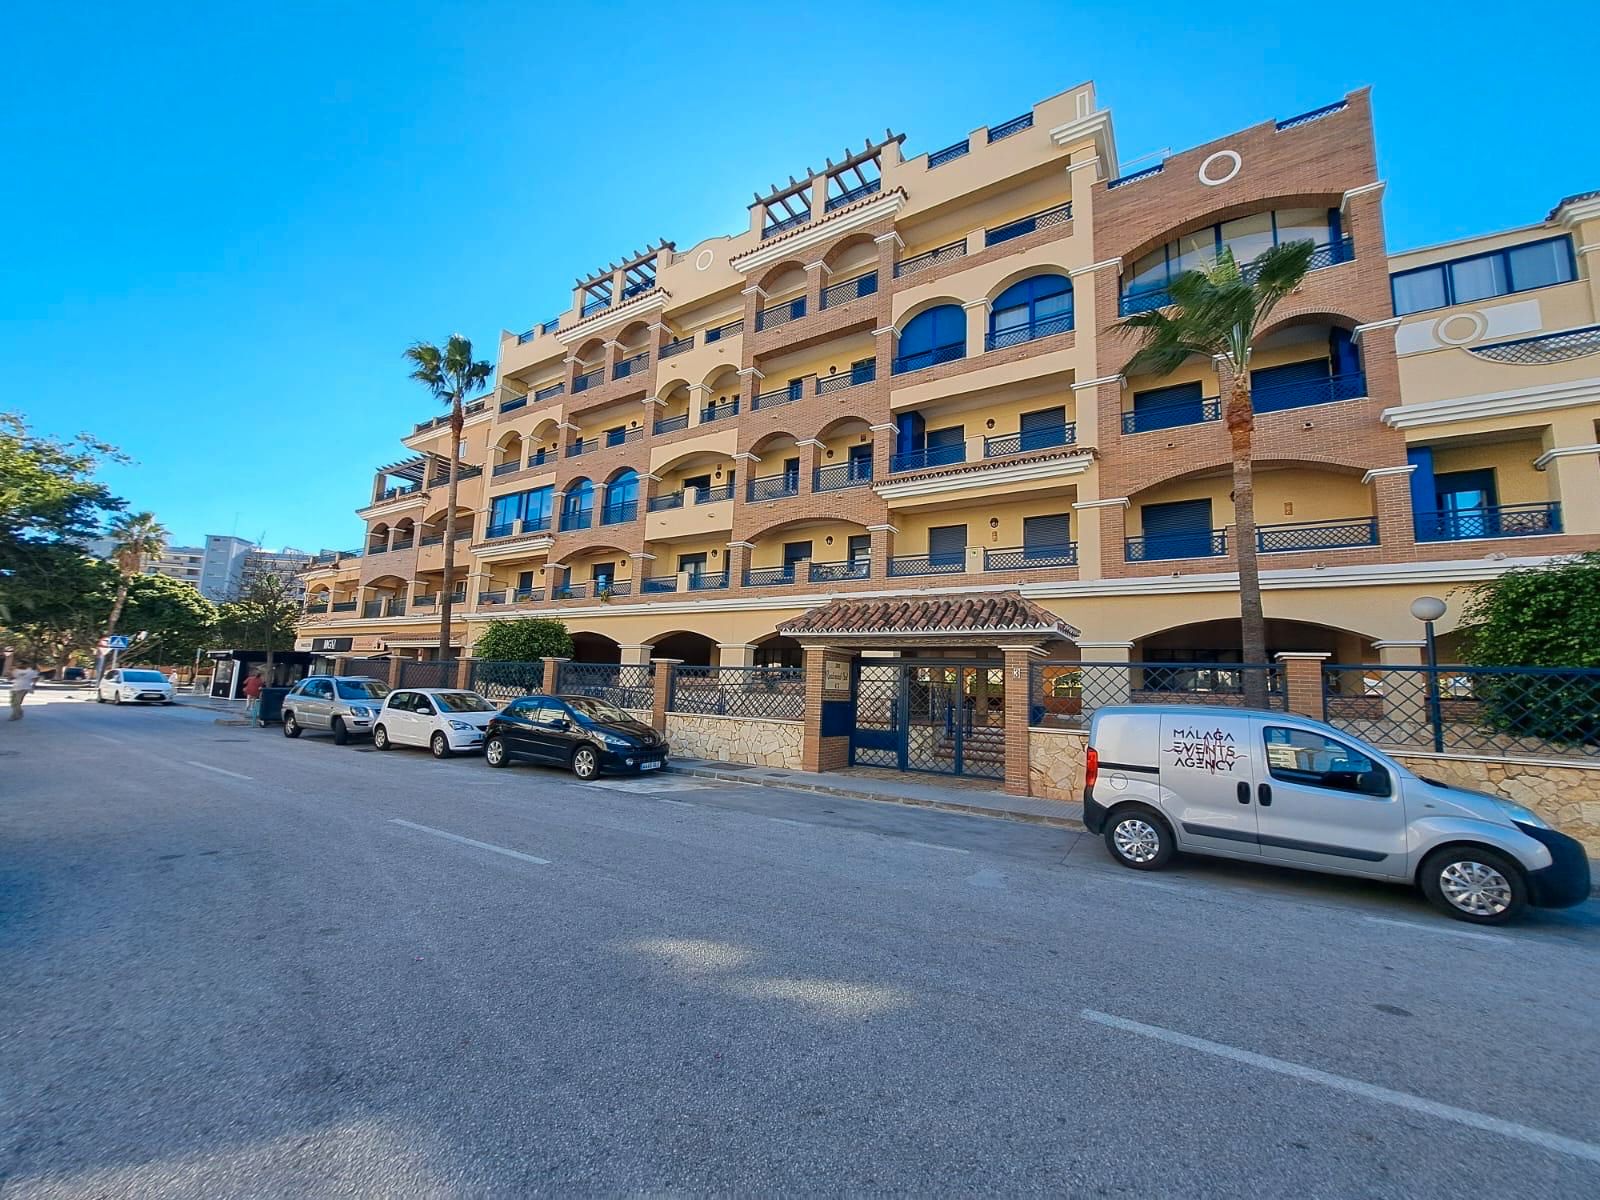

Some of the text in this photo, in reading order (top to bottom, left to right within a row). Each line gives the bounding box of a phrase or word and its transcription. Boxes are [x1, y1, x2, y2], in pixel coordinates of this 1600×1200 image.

[1173, 726, 1235, 742] MÁLAGA
[1173, 741, 1236, 757] EVENTS
[1174, 757, 1236, 771] AGENCY
